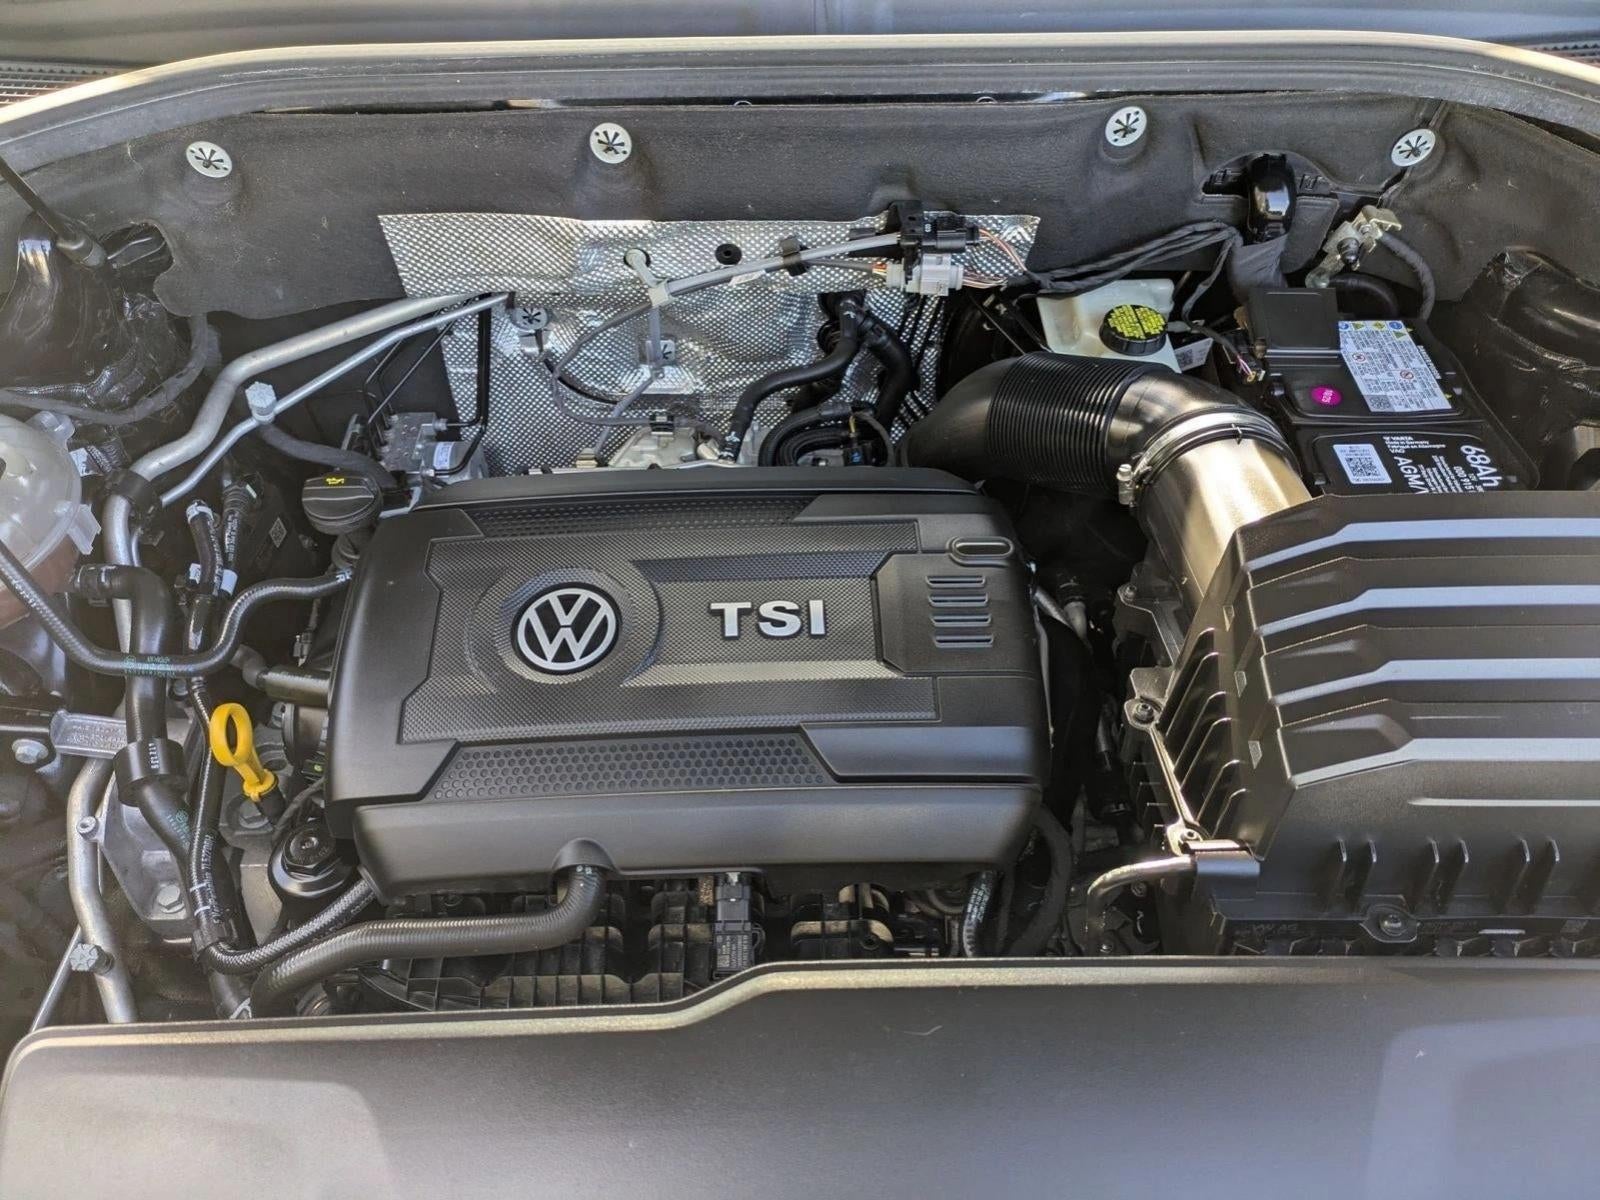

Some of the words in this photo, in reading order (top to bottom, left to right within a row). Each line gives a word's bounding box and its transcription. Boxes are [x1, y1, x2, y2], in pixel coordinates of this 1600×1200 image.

[1460, 445, 1502, 487] 68Ah
[518, 588, 617, 671] VW
[711, 599, 826, 639] TSI
